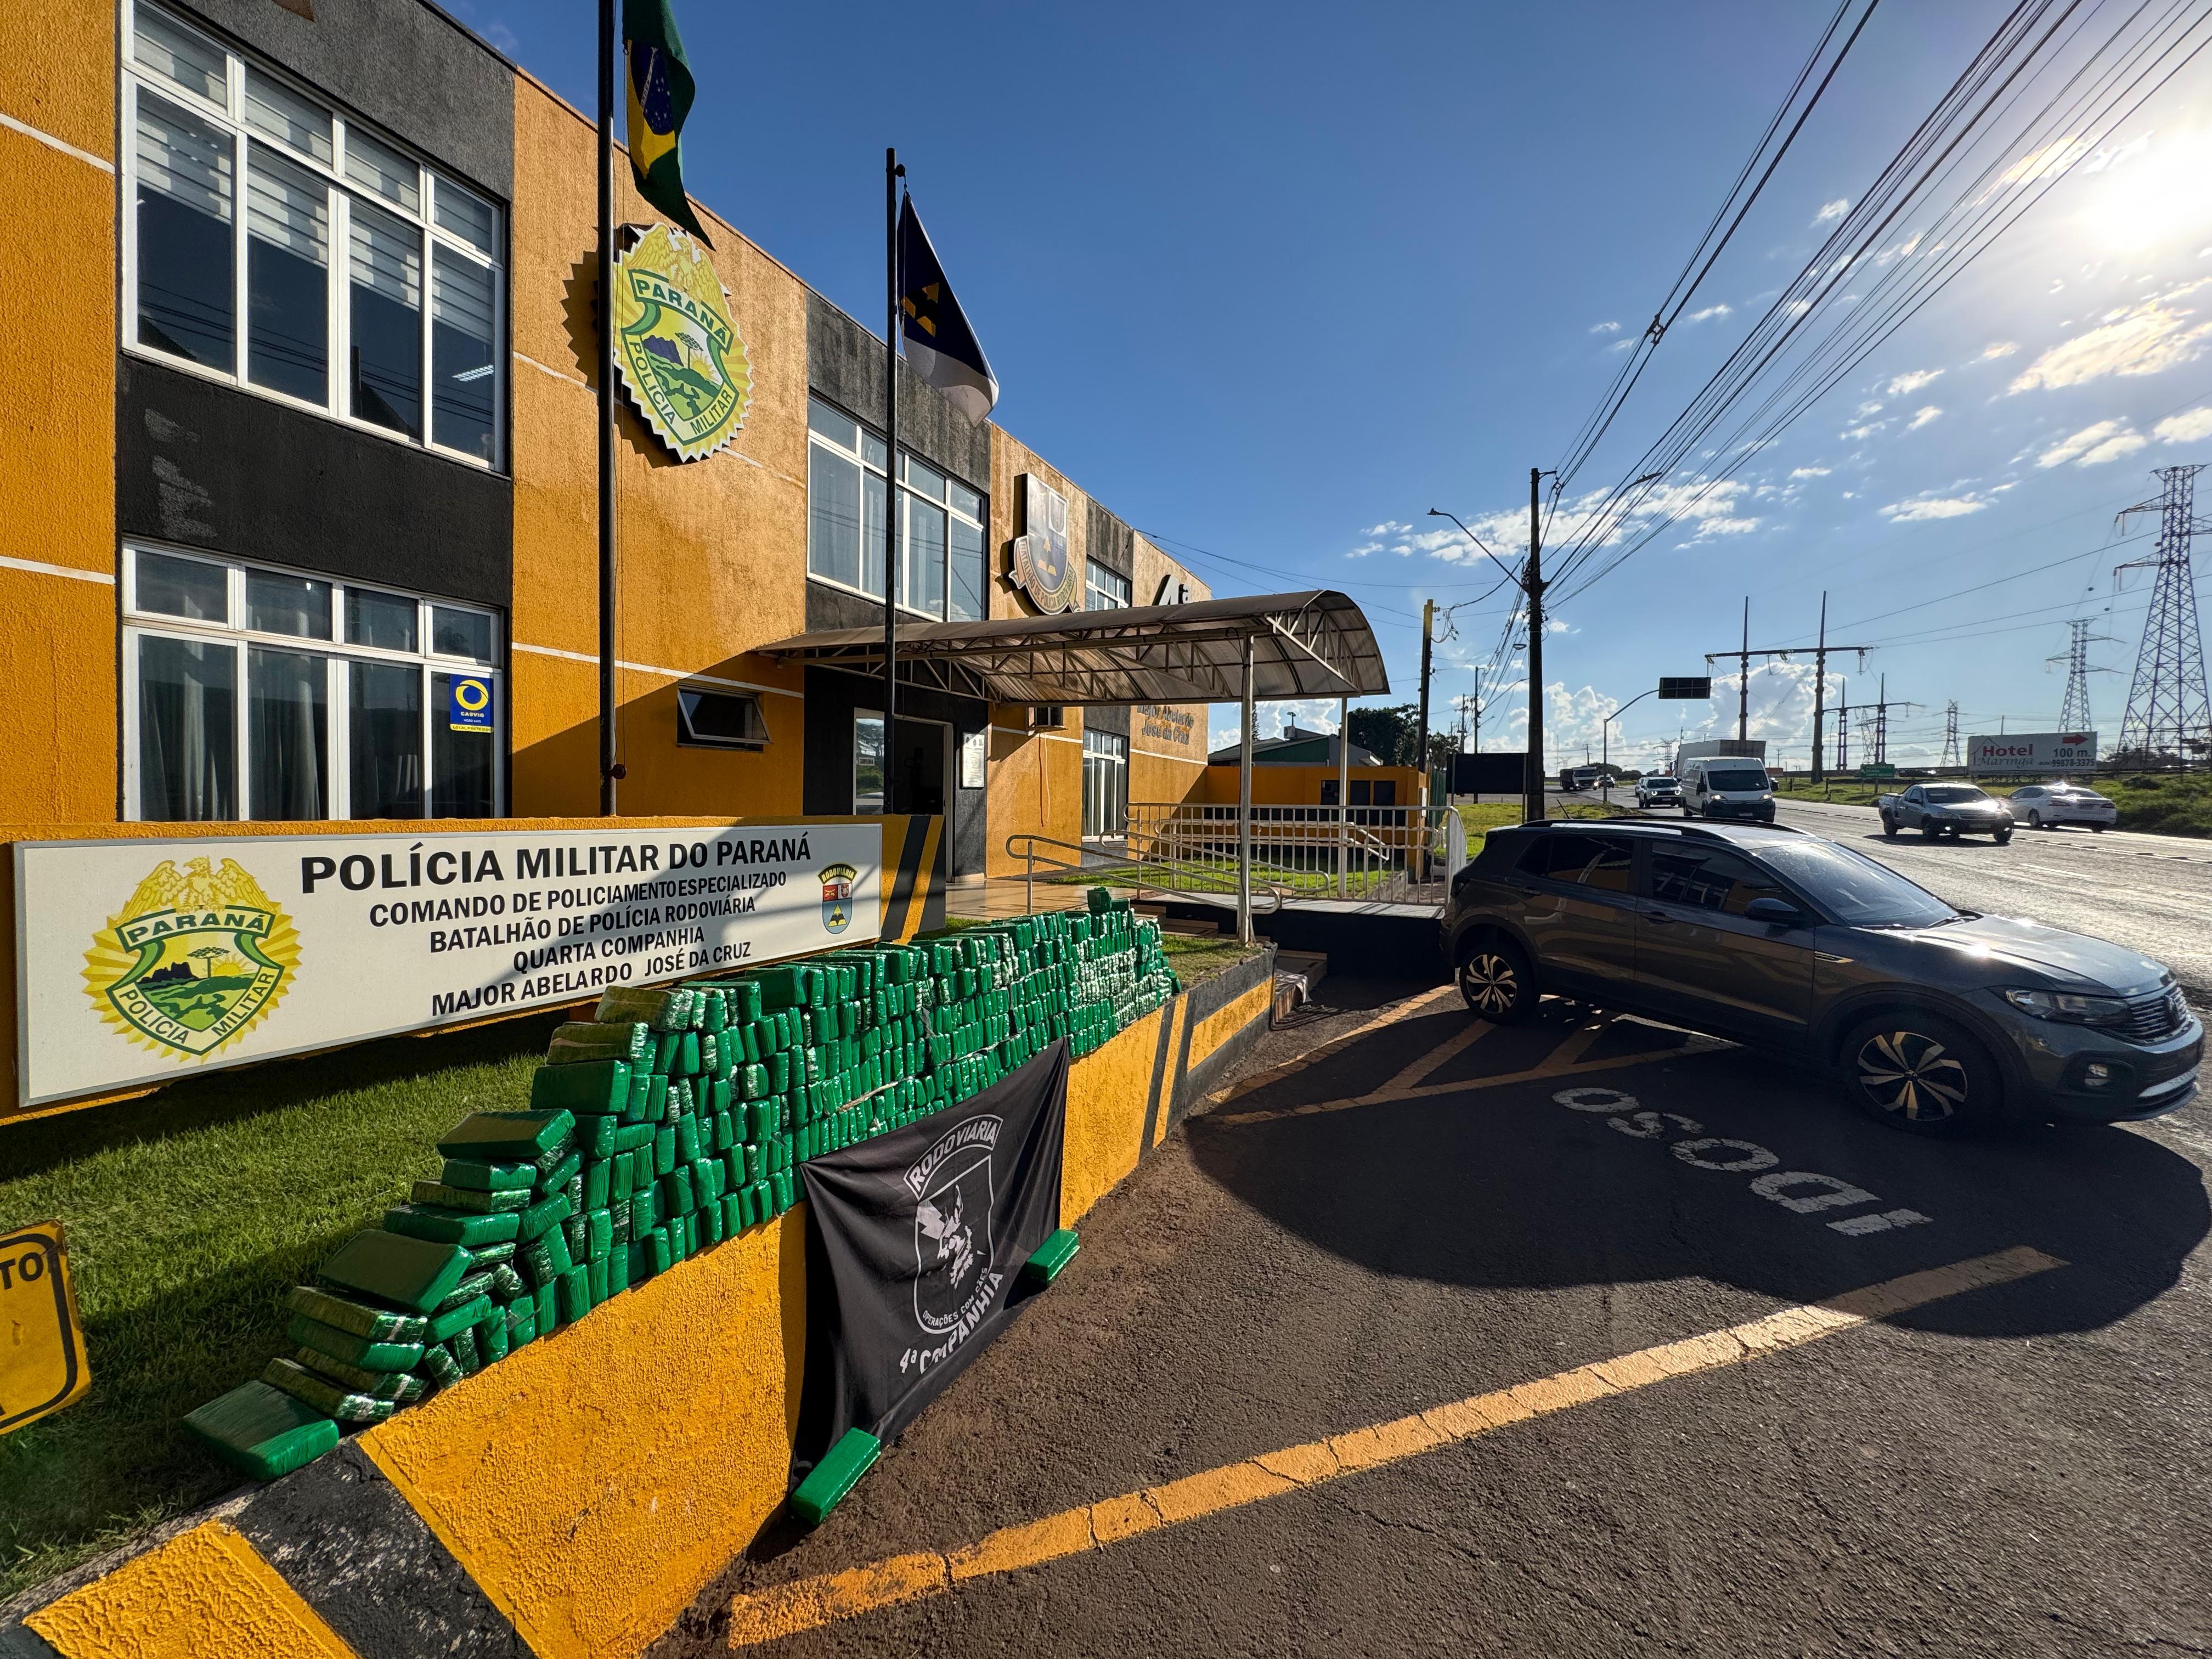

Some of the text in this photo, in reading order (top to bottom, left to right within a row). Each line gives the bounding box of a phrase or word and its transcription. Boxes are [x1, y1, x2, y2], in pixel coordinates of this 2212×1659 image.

[636, 279, 726, 346] PARANÁ
[629, 342, 733, 436] POLÍCIA MILITAR
[1034, 585, 1041, 599] DE
[1173, 726, 1189, 745] Cruz
[1983, 743, 2033, 757] Hotel
[2053, 748, 2073, 758] 100
[302, 831, 811, 894] POLÍCIA MILITAR DO PARANÁ
[821, 867, 854, 883] RODOVIÁRIA
[126, 913, 266, 943] PARANÁ
[370, 871, 787, 927] COMANDO DE POLICIAMENTO ESPECIALIZADO
[431, 895, 755, 953] BATALHÃO DE POLÍCIA RODOVIÁRIA
[432, 941, 751, 1016] MAJOR ABELARDO JOSÉ DA CRUZ
[514, 927, 704, 974] QUARTA COMPANHIA
[119, 970, 277, 1045] POLÍCIA MILITAR
[910, 1118, 997, 1192] RODOVIÁRIA
[1551, 1087, 1934, 1237] IDOSO
[922, 1267, 988, 1328] OPERAÇÕES COM CÃES
